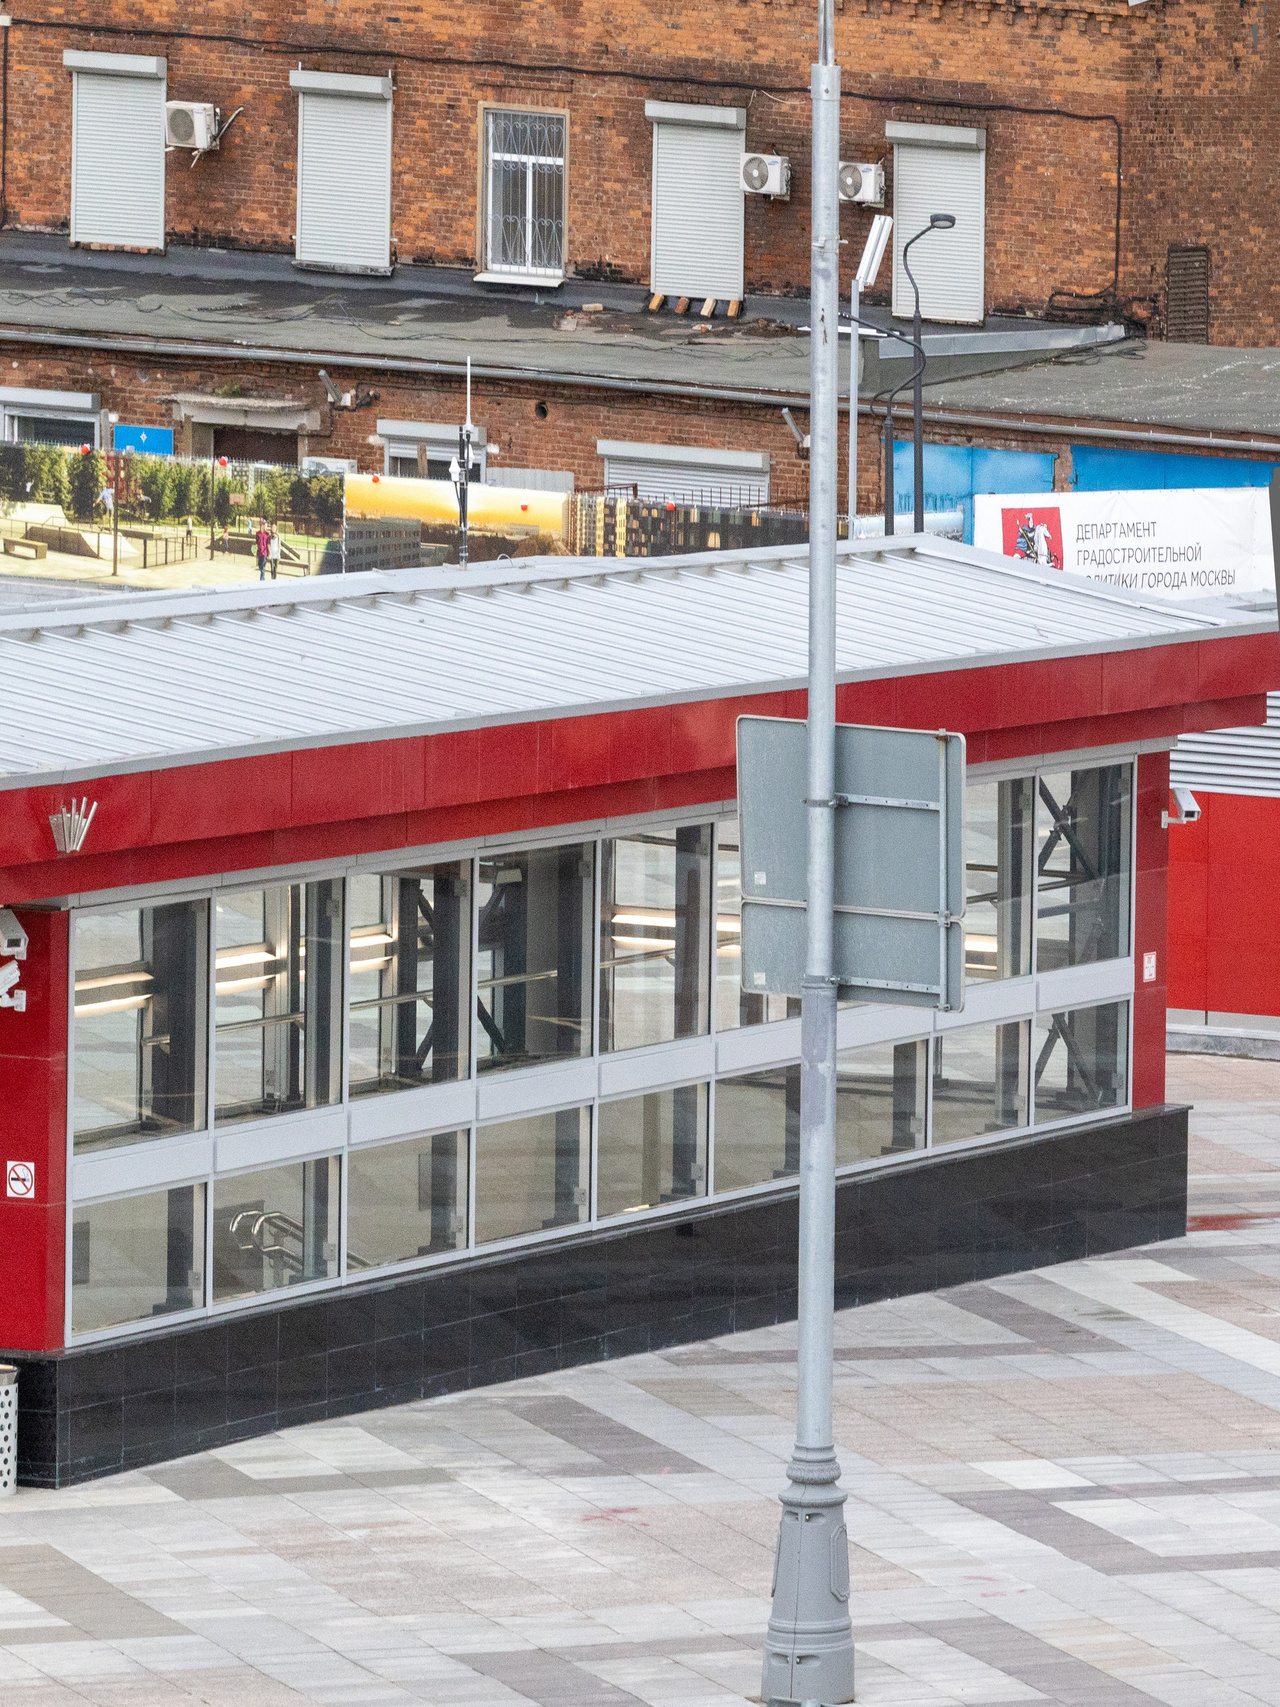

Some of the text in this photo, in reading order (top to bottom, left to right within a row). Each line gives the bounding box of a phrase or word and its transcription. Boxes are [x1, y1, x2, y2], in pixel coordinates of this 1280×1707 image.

[1075, 521, 1157, 543] ДЕПАРТАМЕНТ
[1077, 542, 1202, 567] ГРАДОСТРОИТЕЛЬНОЙ
[1140, 571, 1187, 591] ГОРОДА
[1190, 569, 1236, 586] МОСКВЫ
